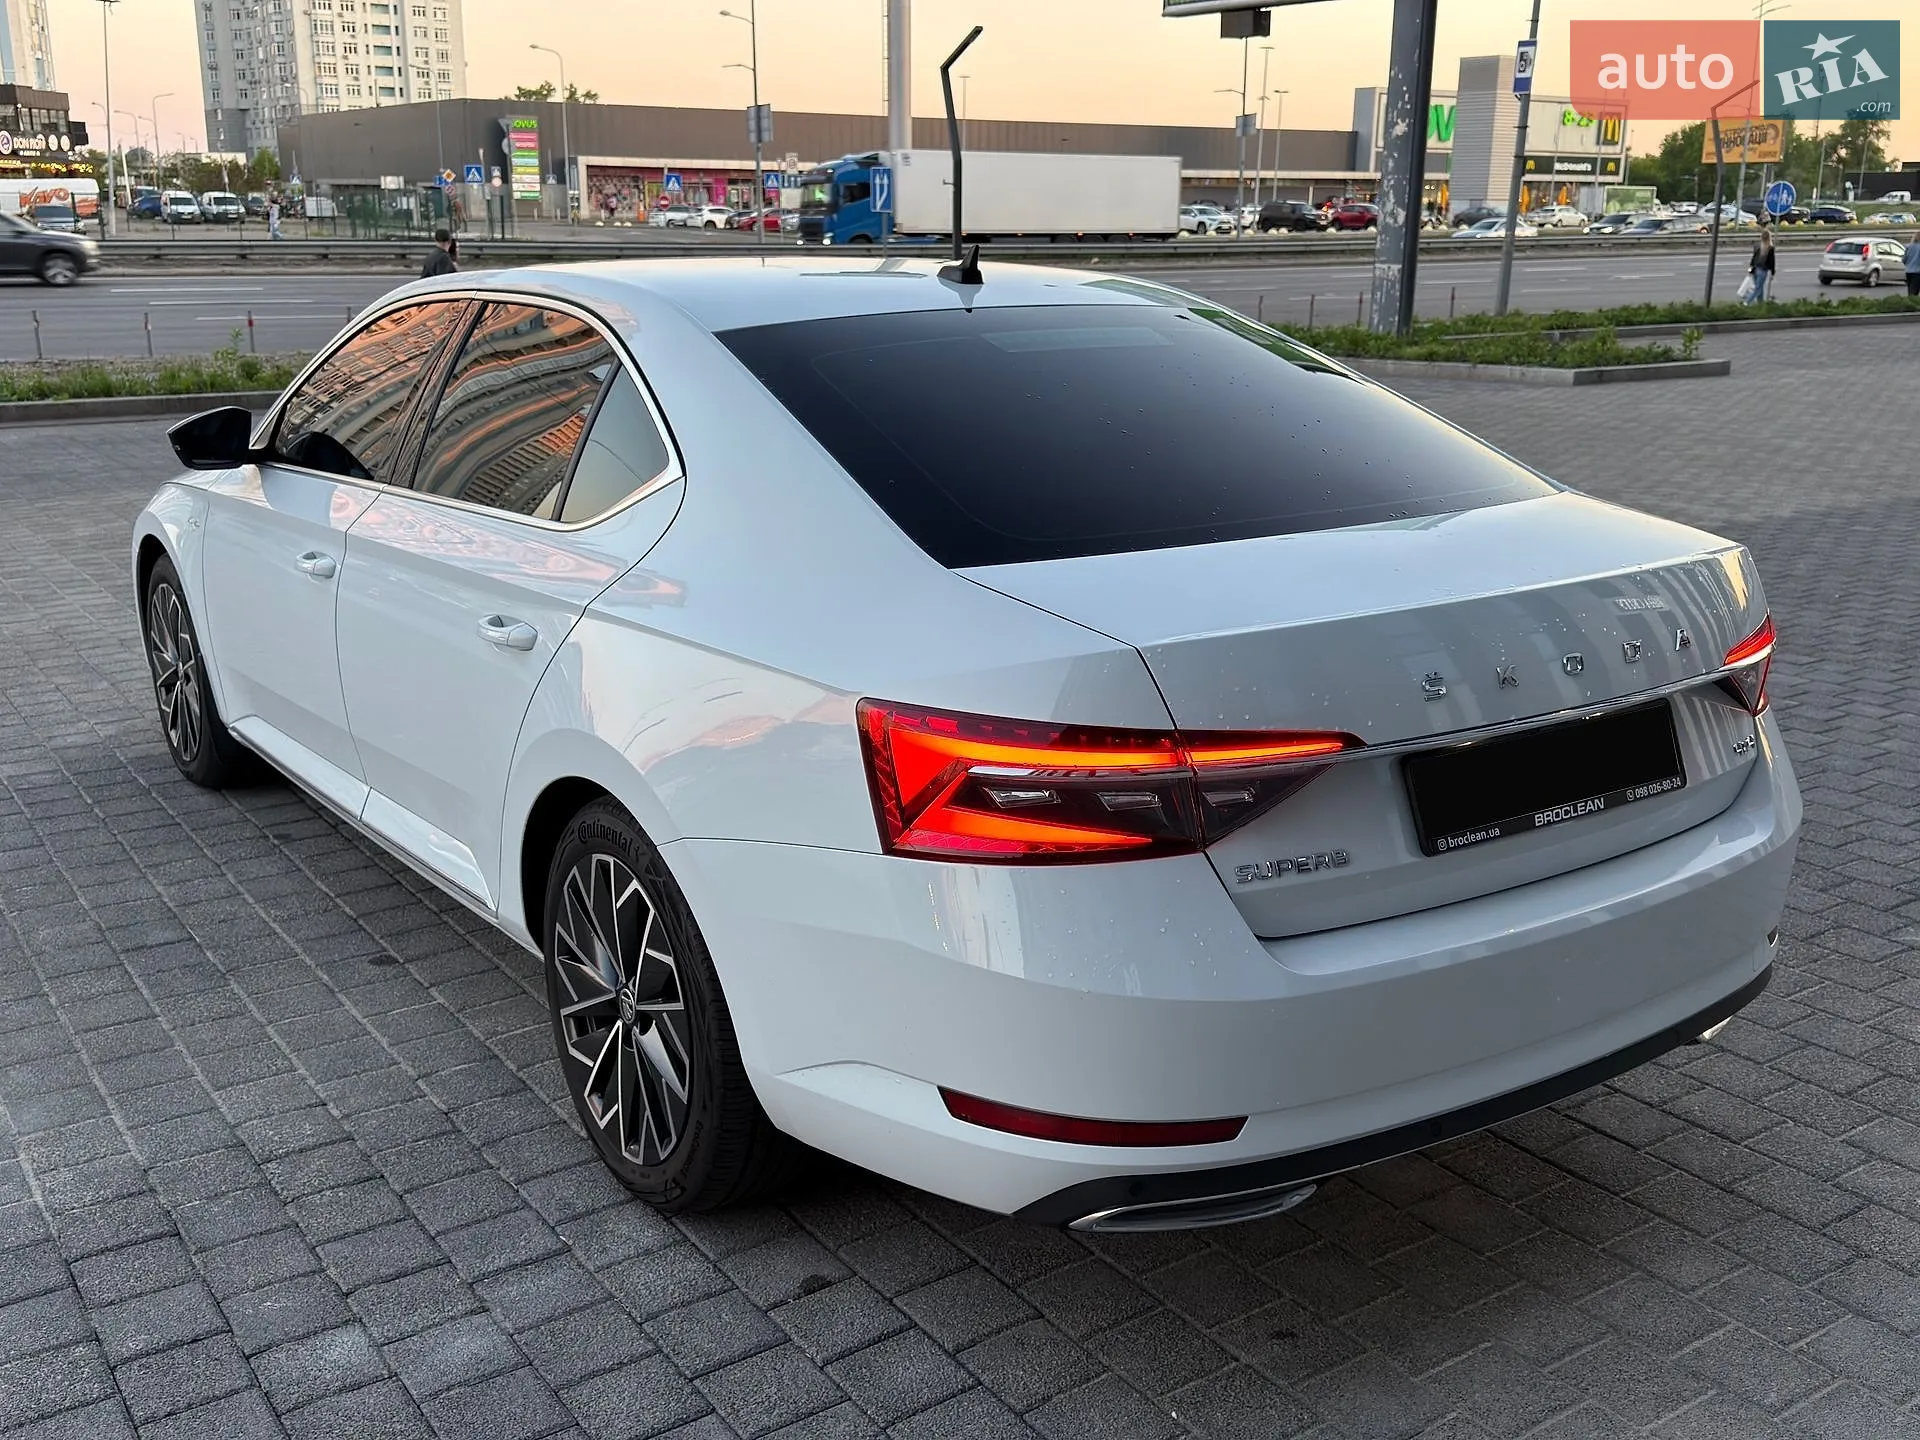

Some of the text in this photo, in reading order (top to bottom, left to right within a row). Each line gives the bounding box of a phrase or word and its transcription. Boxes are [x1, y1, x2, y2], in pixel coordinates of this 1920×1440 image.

[1635, 785, 1649, 800] 098
[1534, 798, 1605, 827] BROCLEAN
[577, 818, 633, 856] Continental
[1447, 827, 1501, 849] broclean.ua
[1235, 848, 1351, 885] SUPERB
